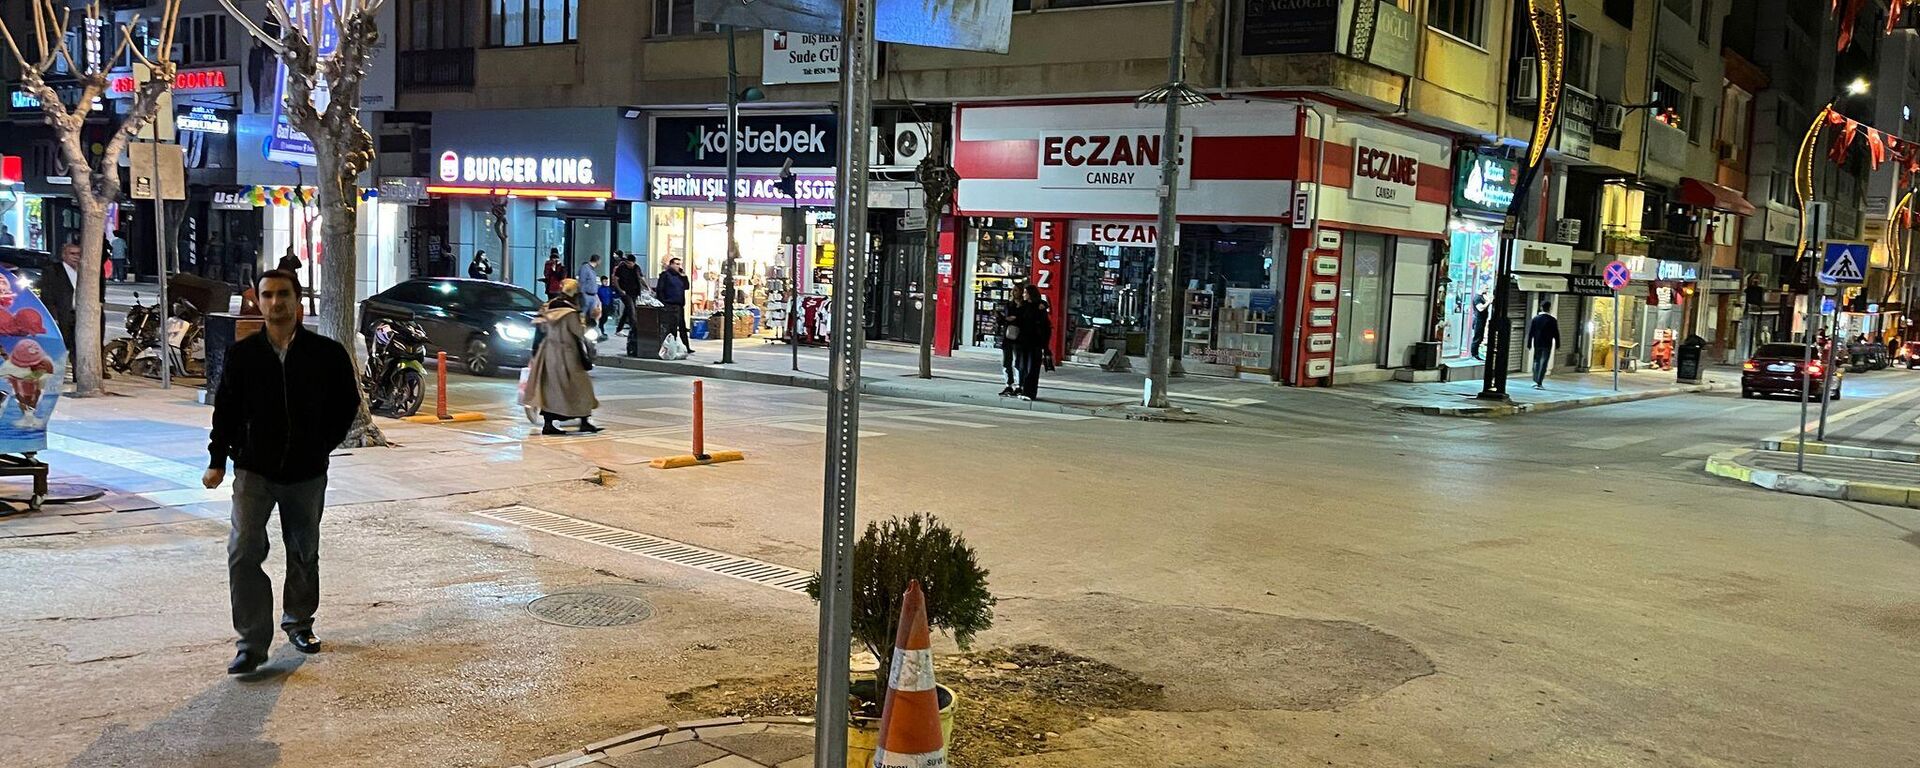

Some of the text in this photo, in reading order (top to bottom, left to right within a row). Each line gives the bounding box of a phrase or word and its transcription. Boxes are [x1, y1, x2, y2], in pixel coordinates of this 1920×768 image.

[789, 45, 839, 63] Sude GÜ
[700, 124, 826, 159] köstebek
[464, 157, 538, 182] BURGER
[1357, 146, 1417, 186] ECZANE
[653, 173, 700, 199] ŞEHRİN
[702, 178, 750, 201] IŞILISI
[1086, 172, 1135, 185] CANBAY
[1376, 186, 1396, 200] CANBAY
[1297, 199, 1304, 220] E
[1091, 224, 1158, 243] ECZAN
